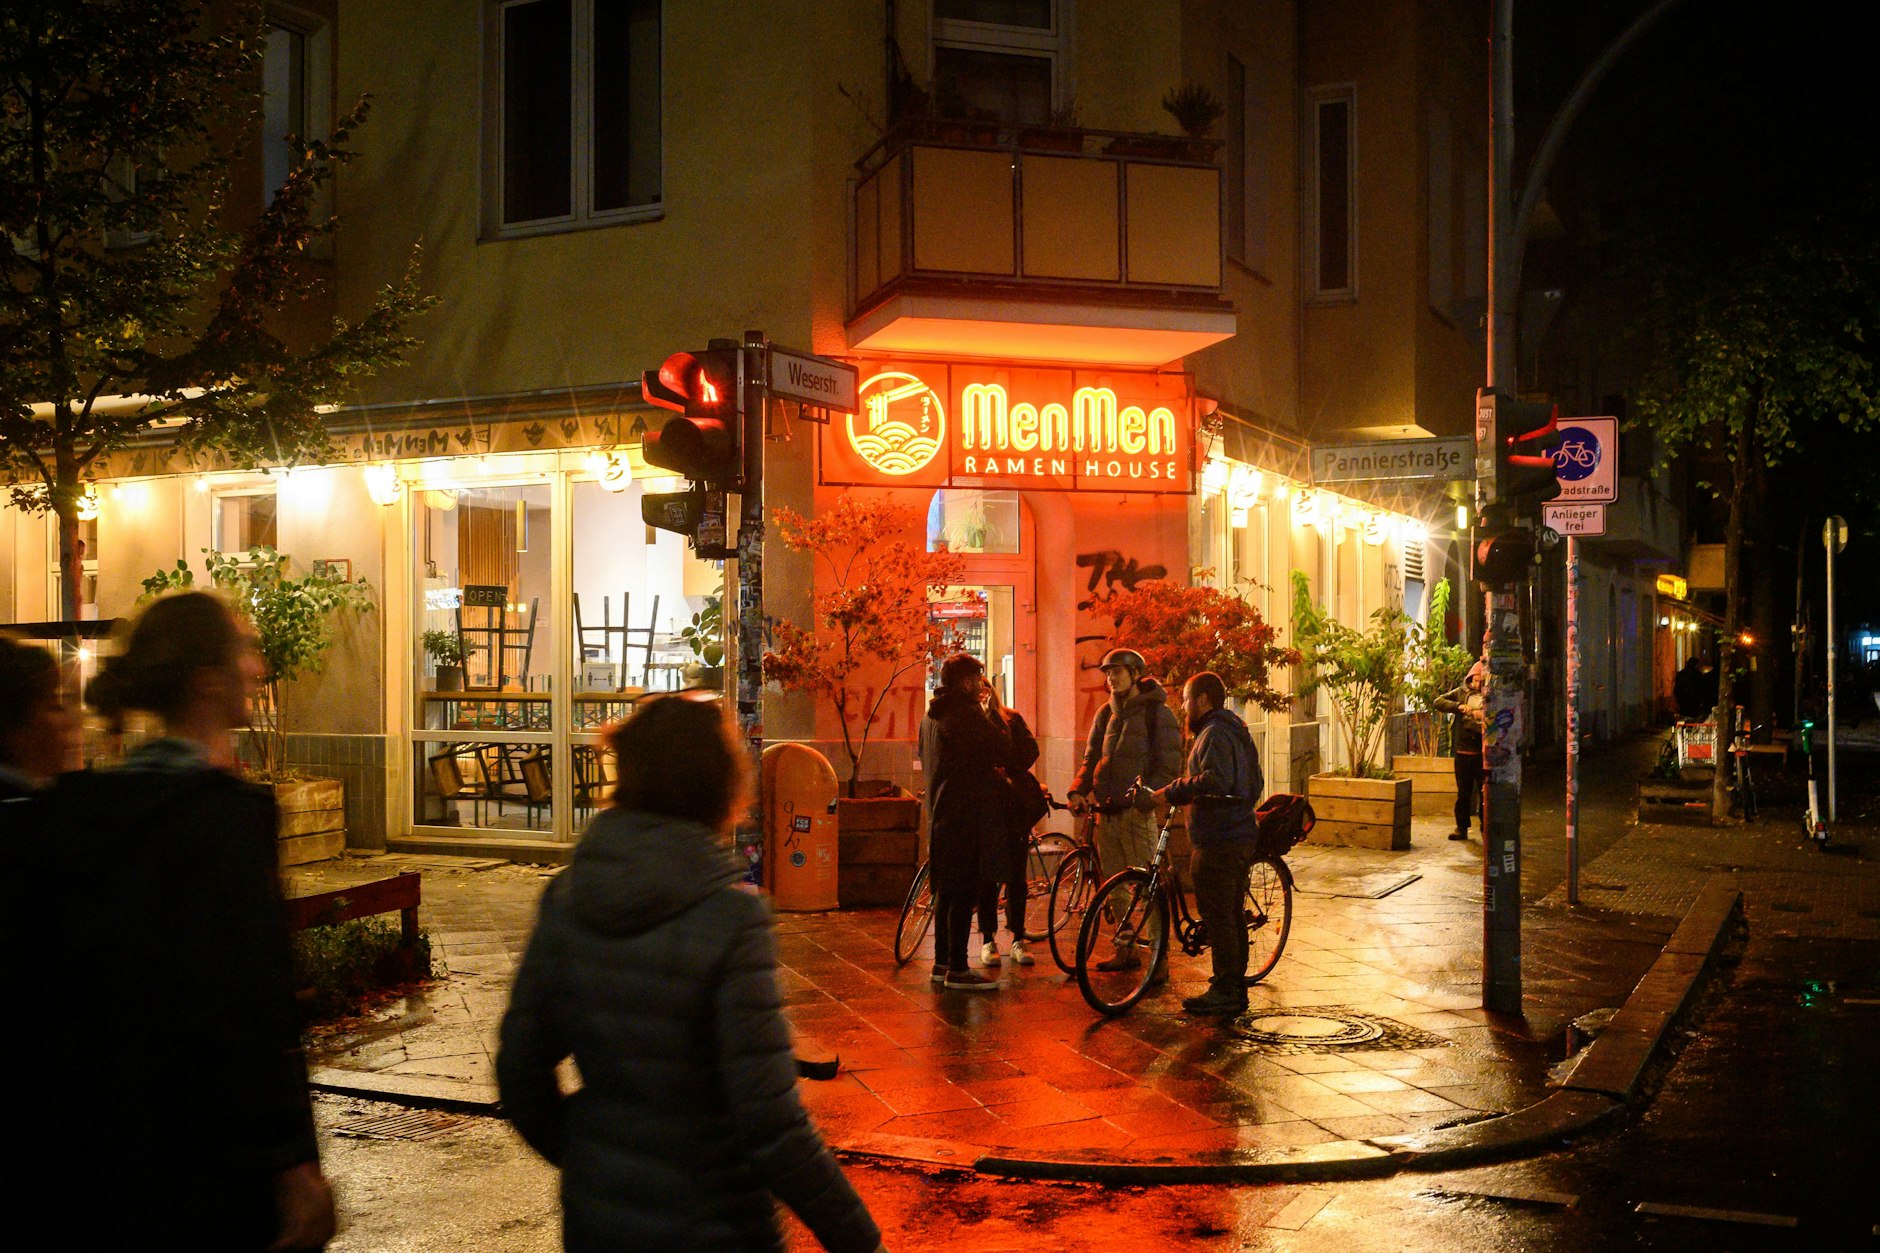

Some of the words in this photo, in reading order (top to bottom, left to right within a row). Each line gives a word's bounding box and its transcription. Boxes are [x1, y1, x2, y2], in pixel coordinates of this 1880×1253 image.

[788, 361, 839, 395] Weserstr.
[920, 396, 931, 433] ラーメン
[961, 382, 1176, 456] MenMen
[965, 456, 1066, 476] RAMEN
[1085, 460, 1177, 479] HOUSE
[1323, 447, 1461, 472] Pannierstraße
[1551, 509, 1598, 523] Anlieger
[1565, 519, 1584, 530] frei
[469, 590, 501, 602] OPEN
